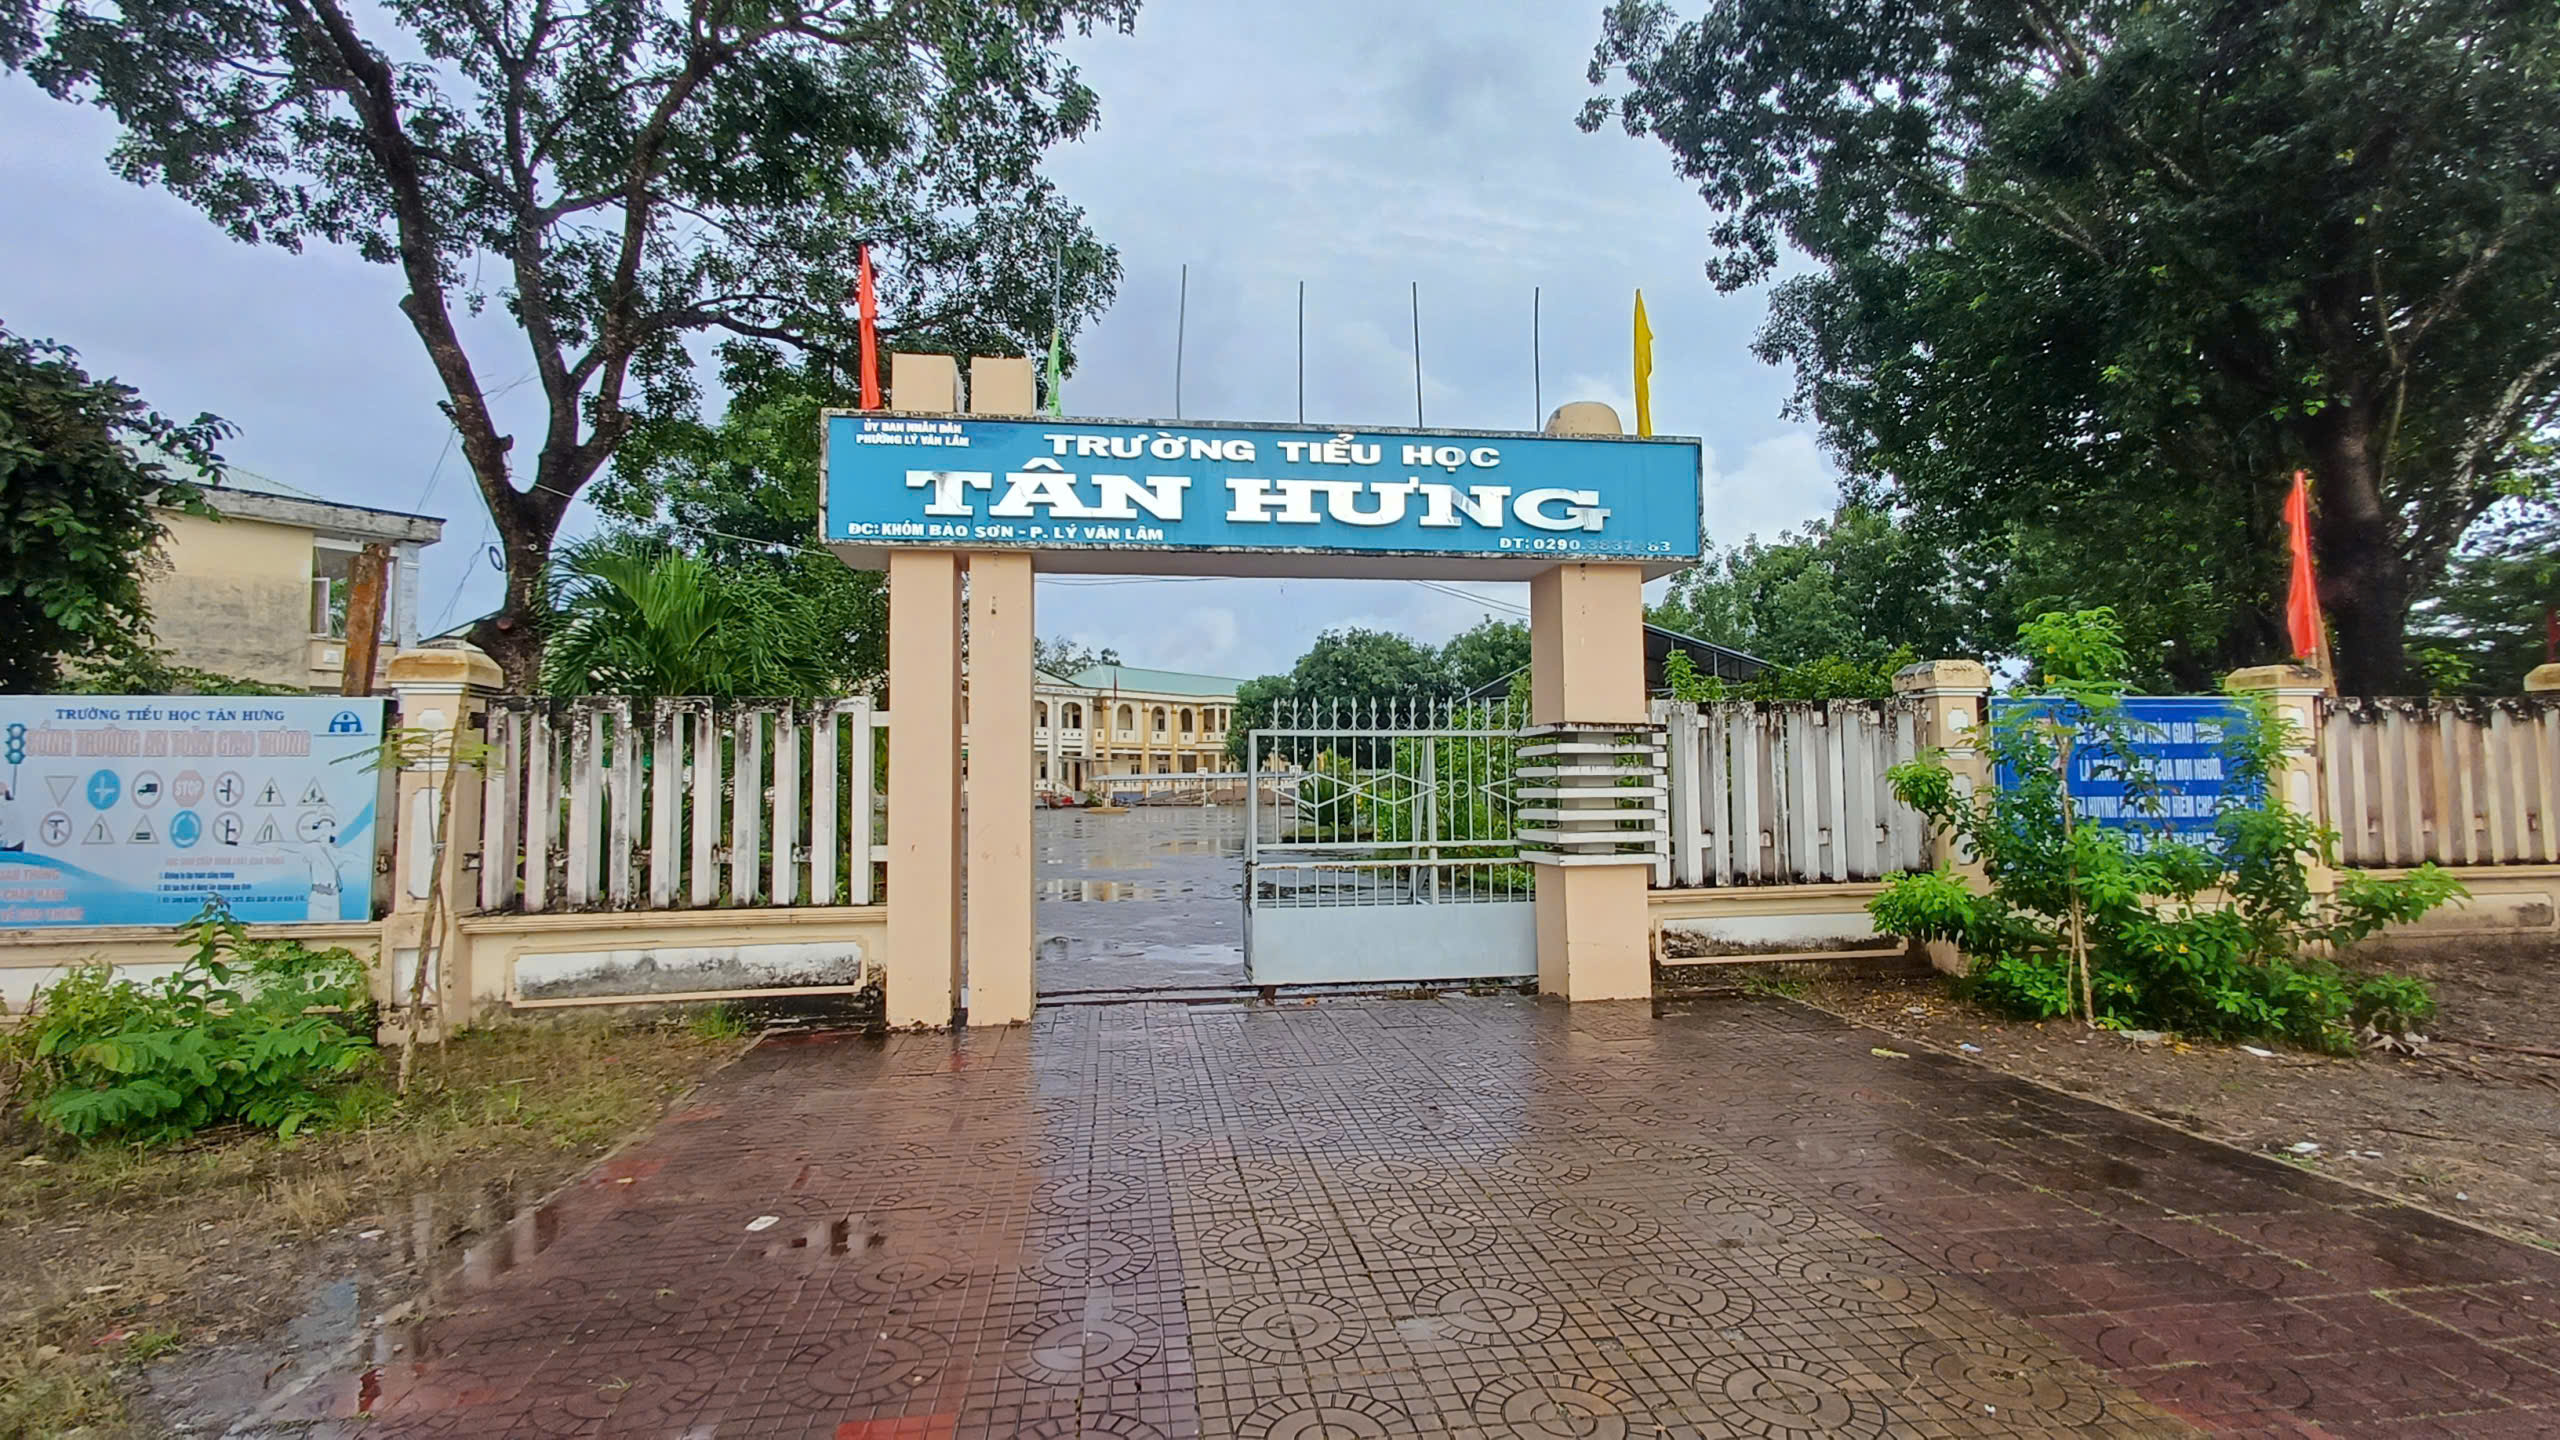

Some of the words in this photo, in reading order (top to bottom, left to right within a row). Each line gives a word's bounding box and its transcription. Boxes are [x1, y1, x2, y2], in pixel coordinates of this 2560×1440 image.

[881, 421, 904, 432] BAN
[906, 420, 937, 433] NHÂN
[938, 422, 962, 434] DÂN
[856, 432, 902, 444] PHƯỜNG
[904, 433, 918, 445] LÝ
[945, 435, 969, 447] LÂM
[1043, 432, 1256, 462] TRƯỜNG
[1277, 433, 1381, 465] TIỂU
[1402, 445, 1500, 473] HỌC
[906, 457, 1192, 522] TÂN
[1225, 475, 1611, 532] HƯNG
[848, 523, 879, 537] ĐC:
[881, 522, 924, 537] KHÓM
[974, 524, 1014, 538] SƠN
[1030, 528, 1048, 539] P.
[1053, 524, 1077, 540] LÝ
[1083, 526, 1120, 541] VĂN
[1125, 526, 1164, 541] LÂM
[56, 707, 120, 720] TRƯỜNG
[127, 705, 162, 721] TIỂU
[168, 710, 201, 722] HỌC
[207, 708, 236, 721] TÂN
[242, 709, 285, 721] HƯNG
[2172, 722, 2193, 744] GIAO
[2156, 749, 2174, 780] CỦA
[2088, 796, 2118, 818] HUYNH
[2196, 796, 2214, 817] CHO
